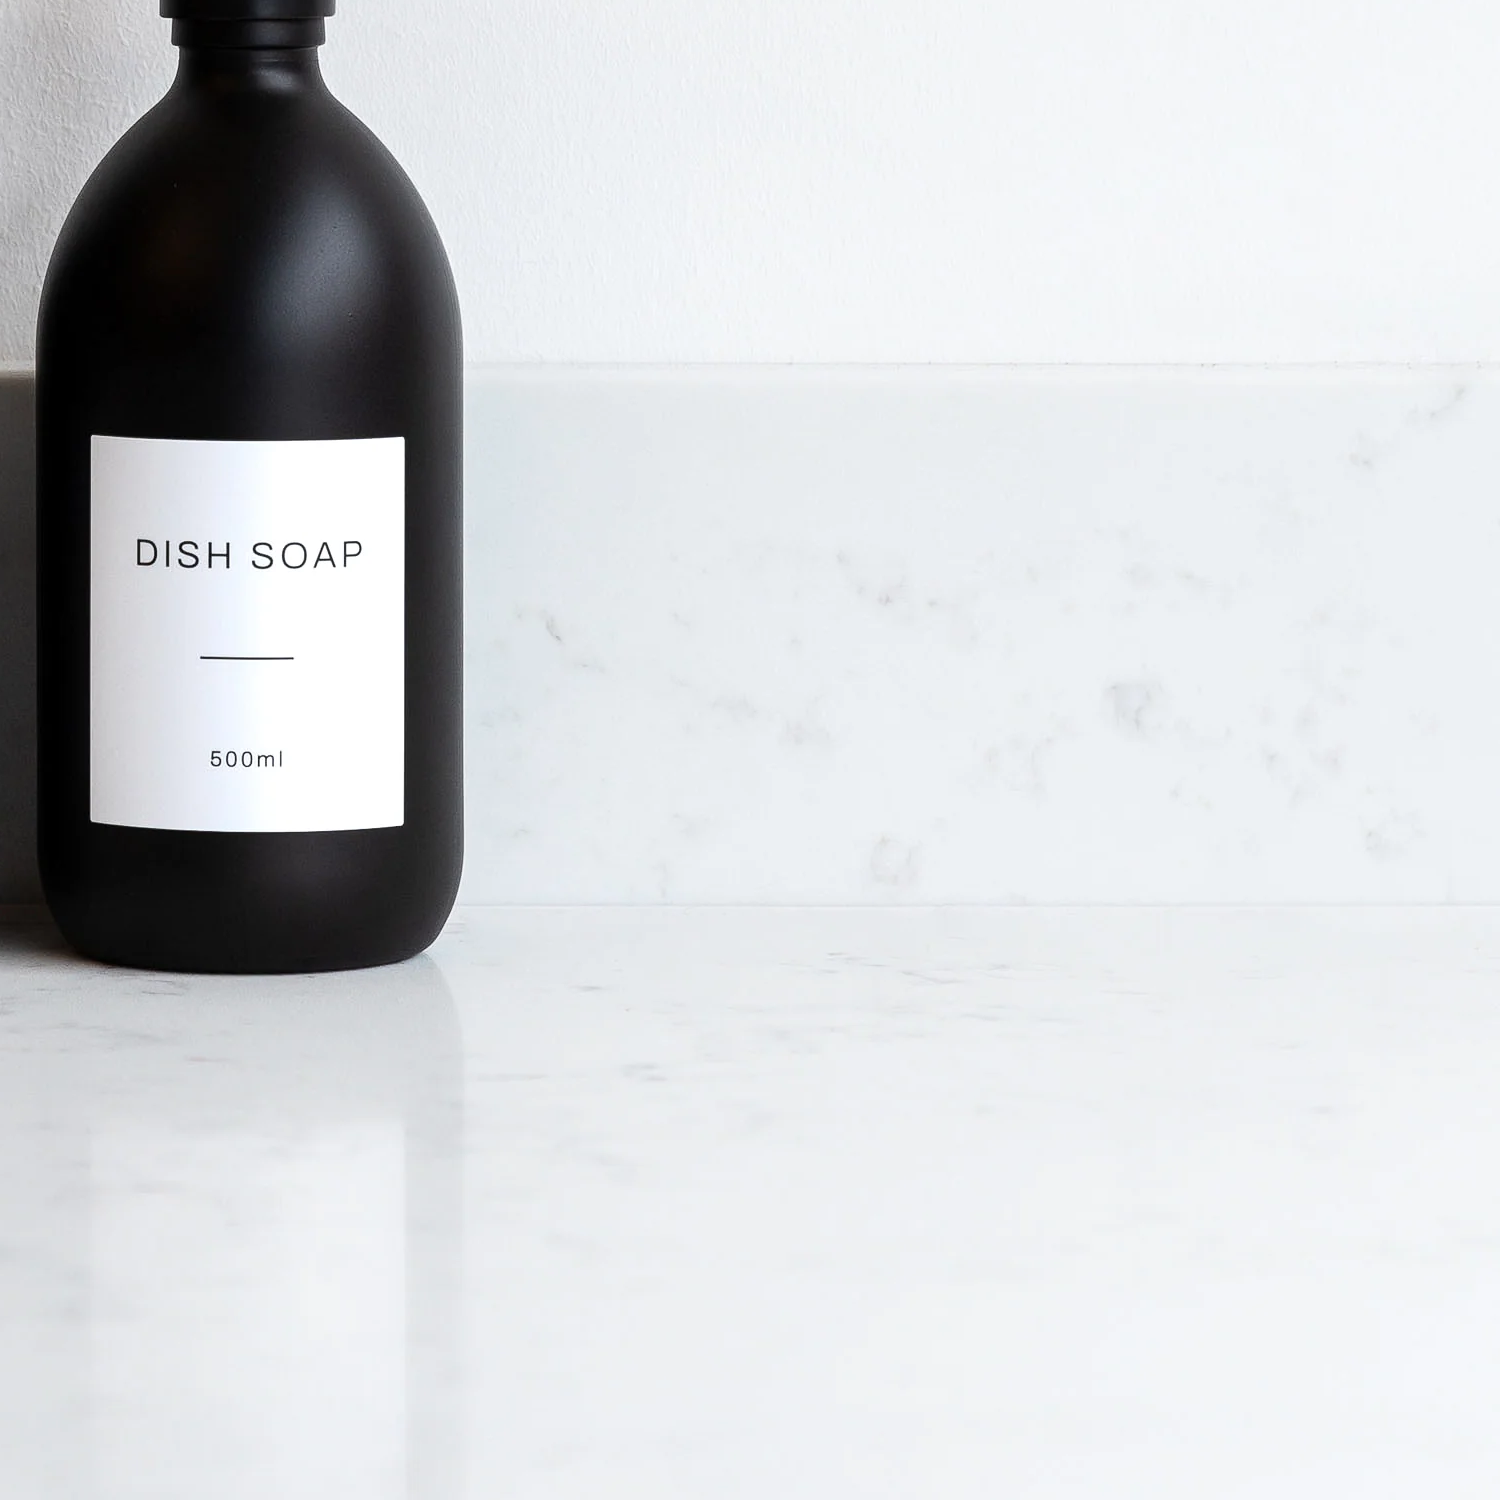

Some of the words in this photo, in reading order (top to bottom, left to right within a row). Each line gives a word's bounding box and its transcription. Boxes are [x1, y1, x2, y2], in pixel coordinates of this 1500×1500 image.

[136, 538, 231, 570] DISH
[251, 540, 363, 570] SOAP
[210, 750, 284, 768] 500ml
